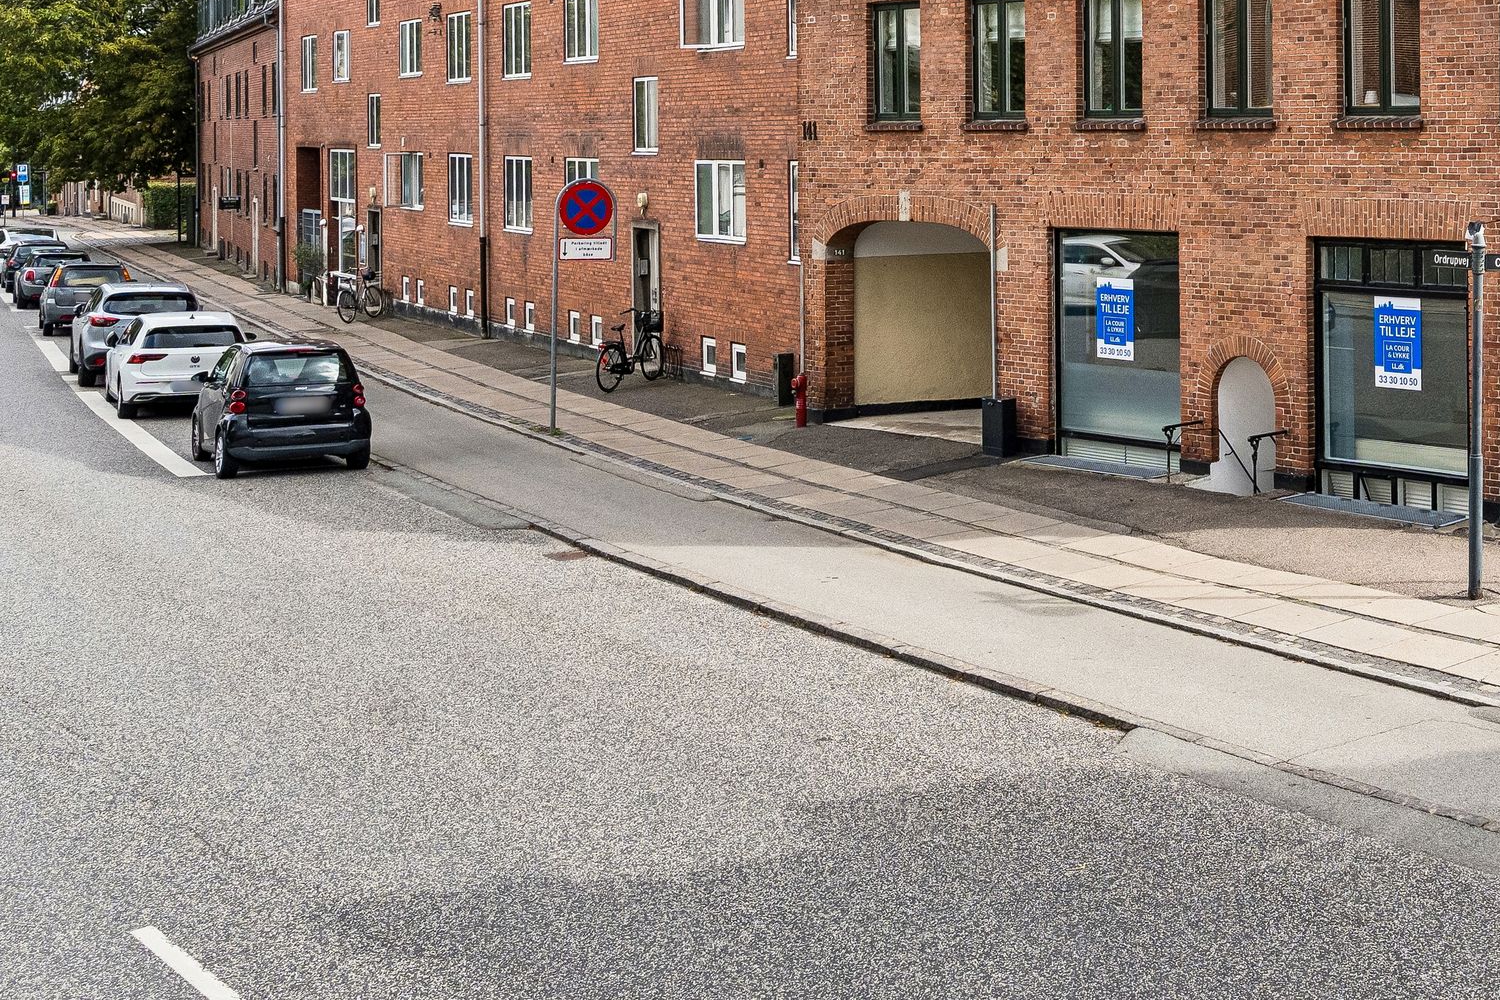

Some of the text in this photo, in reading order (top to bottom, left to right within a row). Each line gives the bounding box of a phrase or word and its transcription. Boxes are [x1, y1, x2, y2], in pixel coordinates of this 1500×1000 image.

[1434, 254, 1469, 268] Ordrupvej
[1100, 293, 1130, 303] ERHVERV
[1100, 303, 1129, 315] TIL LEJE
[1379, 314, 1416, 325] ERHVERV
[1379, 326, 1416, 338] TIL LEJE
[1108, 347, 1115, 355] 30
[1124, 349, 1131, 357] 50
[1379, 375, 1418, 386] 33 30 10 50
